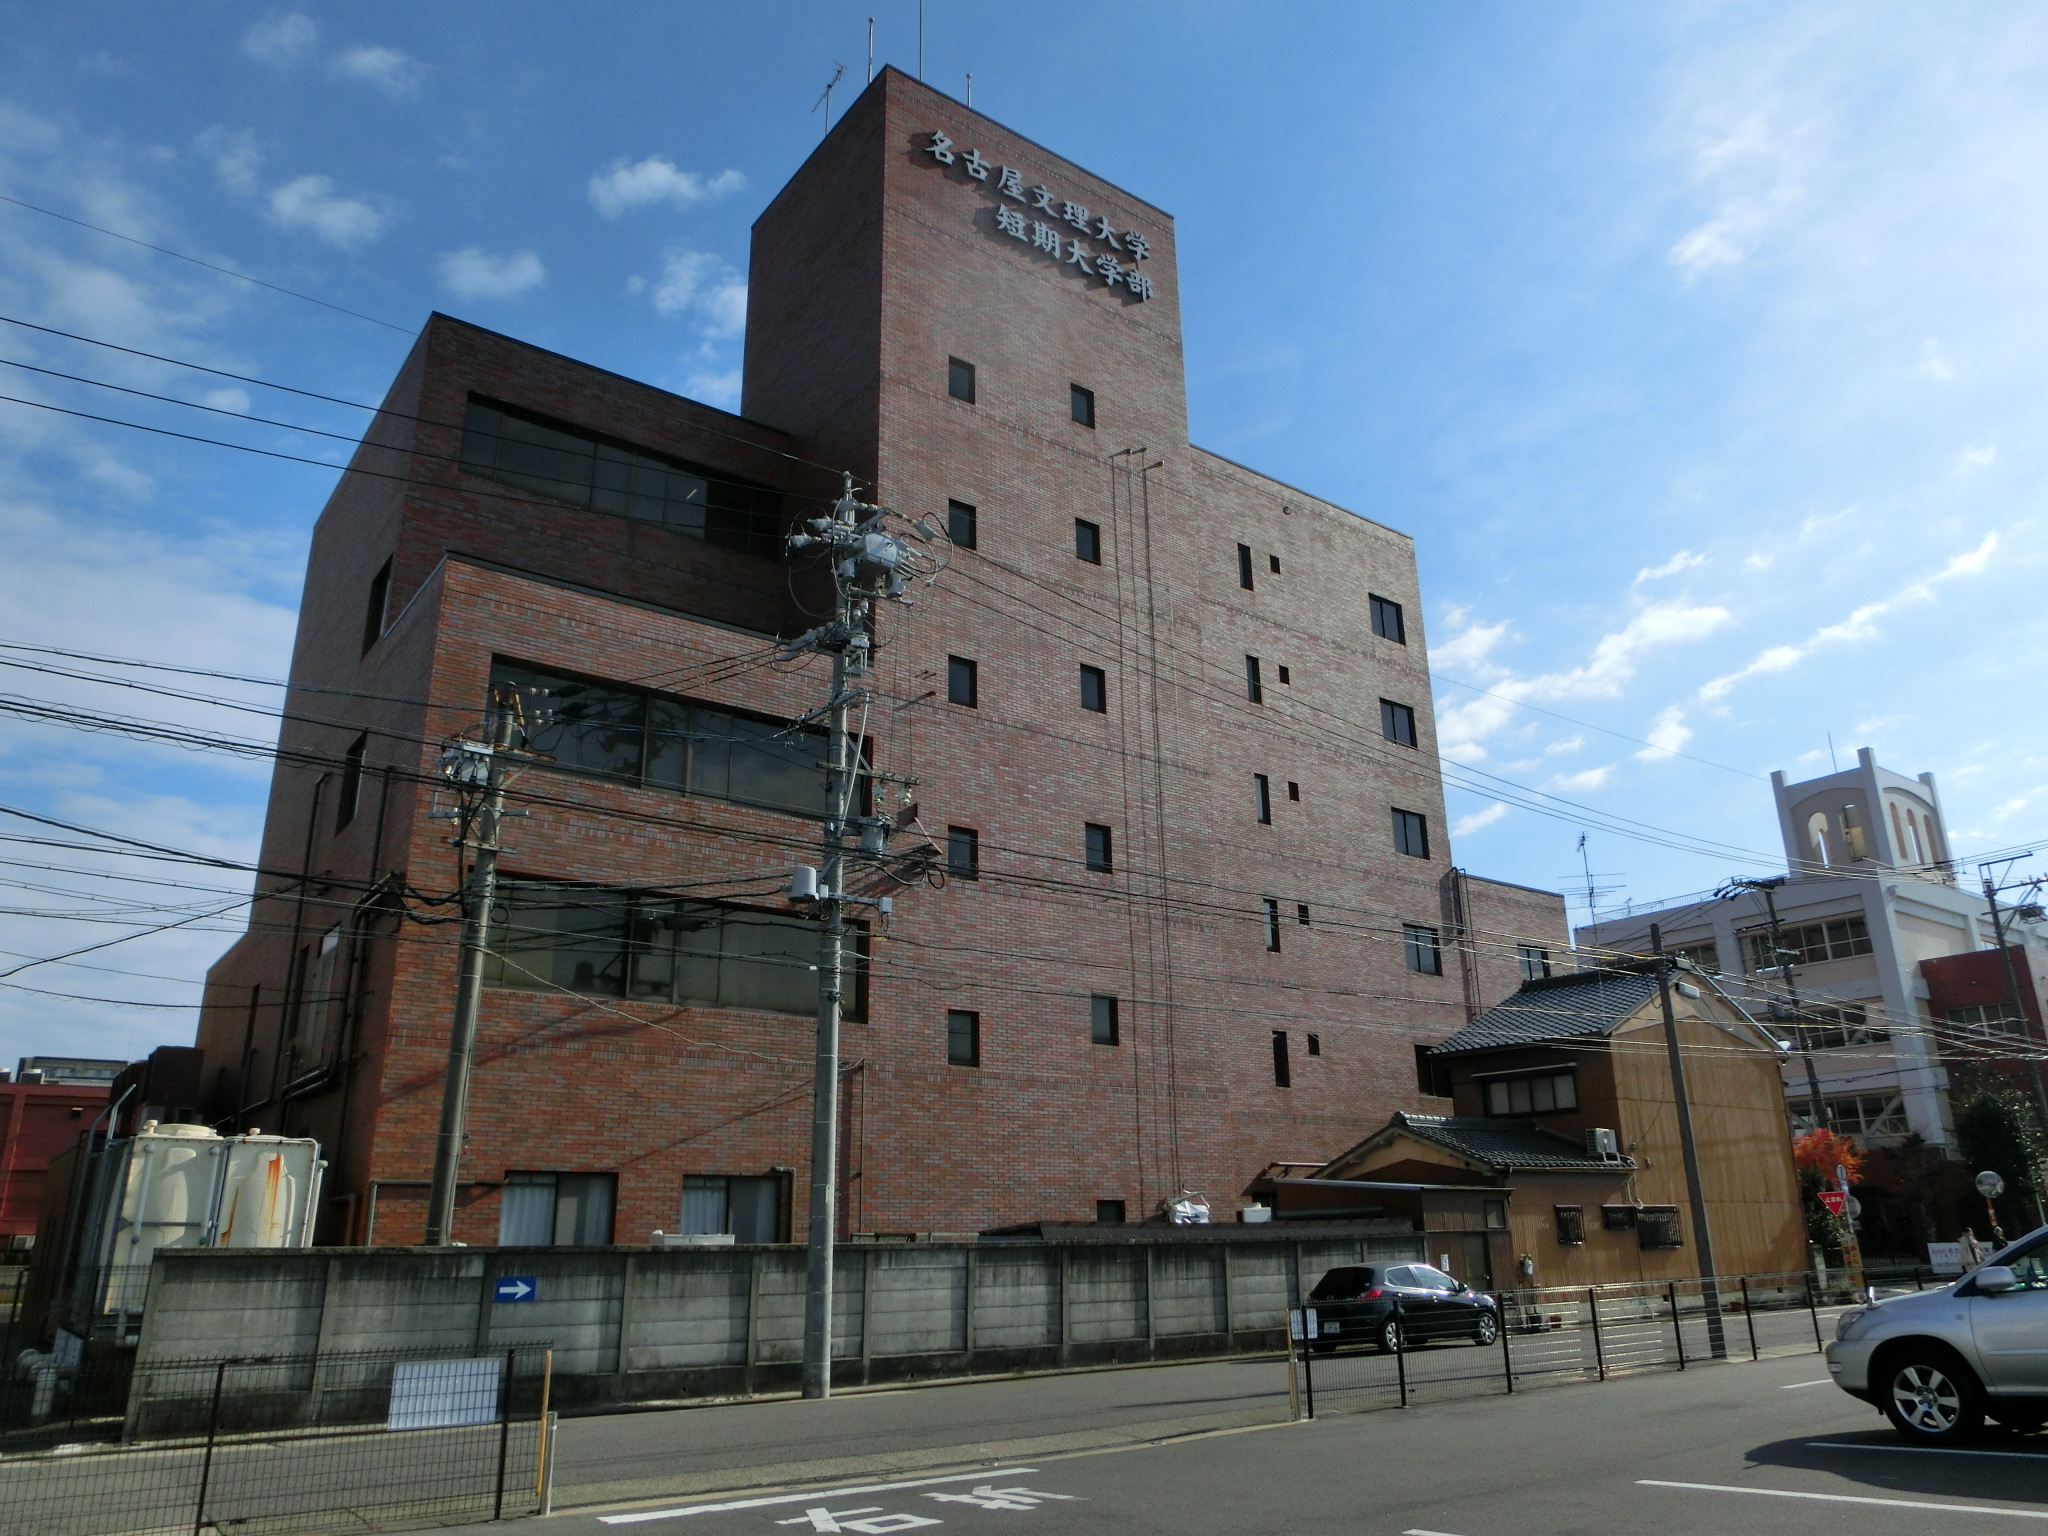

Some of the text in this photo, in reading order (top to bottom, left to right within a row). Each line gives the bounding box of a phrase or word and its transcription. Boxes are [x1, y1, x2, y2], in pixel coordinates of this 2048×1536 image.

[926, 130, 1150, 261] 名古屋文理大学
[996, 204, 1154, 301] 短期大学部
